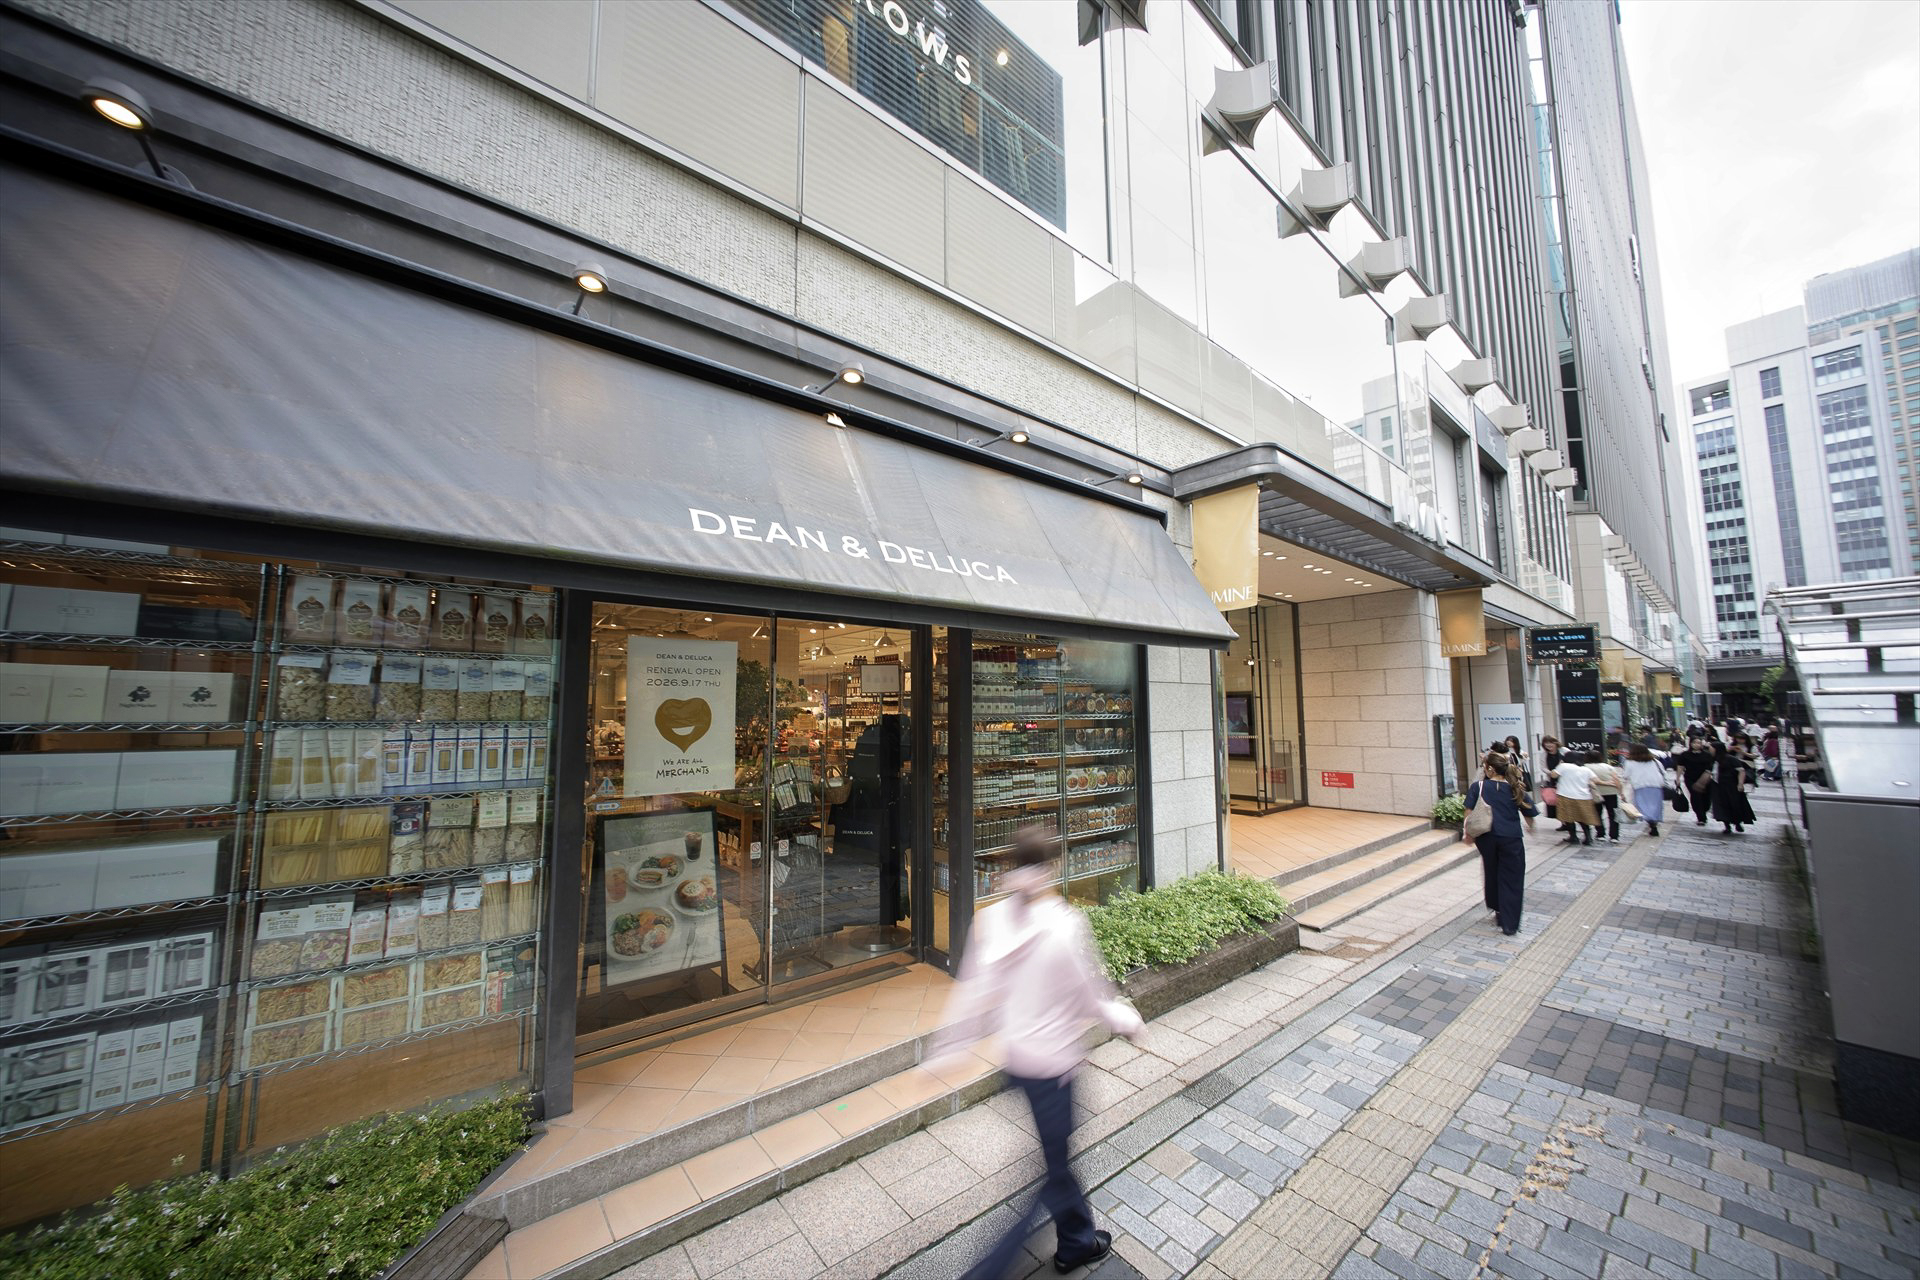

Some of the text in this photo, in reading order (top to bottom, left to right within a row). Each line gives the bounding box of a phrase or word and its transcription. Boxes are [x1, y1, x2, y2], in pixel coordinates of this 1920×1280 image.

[688, 507, 1018, 585] DEAN & DELUCA
[1443, 642, 1483, 654] LUMINE
[646, 666, 721, 676] RENEWAL OPEN
[646, 678, 701, 687] 2026.9.17
[656, 766, 710, 779] MERCHANTS
